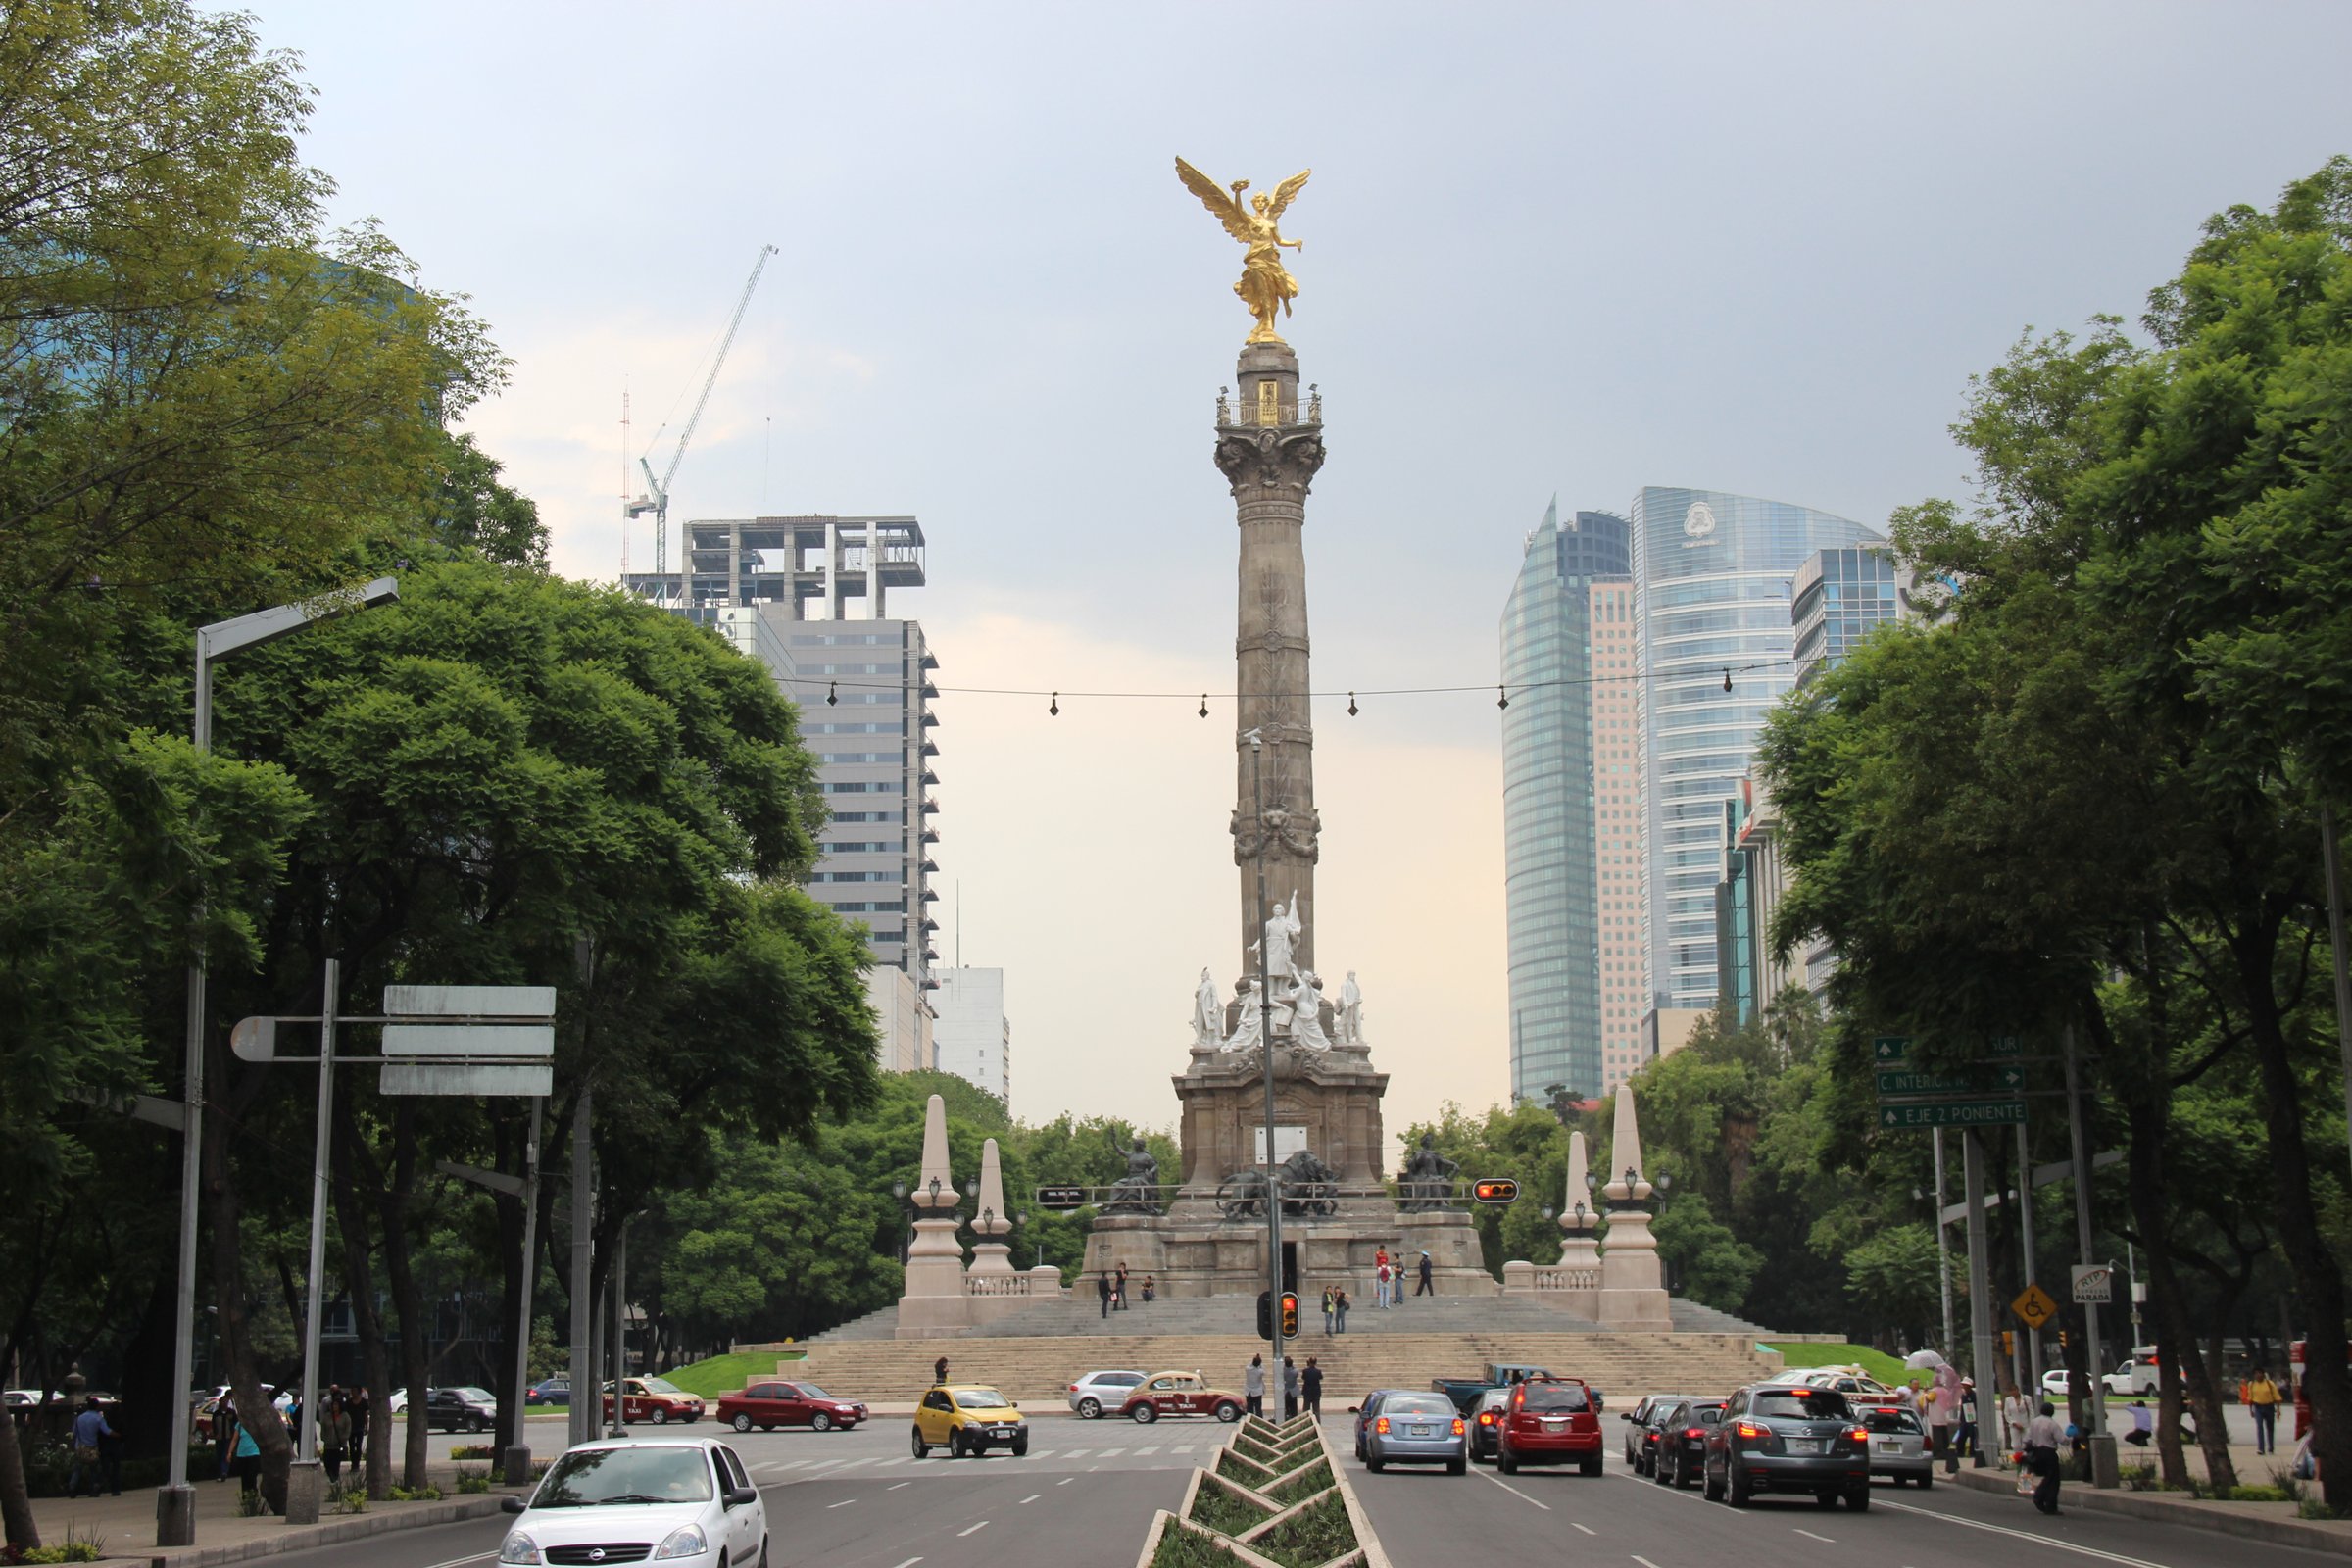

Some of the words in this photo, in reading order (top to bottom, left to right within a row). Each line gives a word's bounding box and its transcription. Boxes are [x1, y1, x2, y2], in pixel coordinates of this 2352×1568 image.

[1880, 1075, 1892, 1090] C.
[1905, 1108, 1932, 1123] EJE
[1937, 1107, 1947, 1122] 2
[1952, 1104, 2024, 1121] PONIENTE
[2081, 1271, 2101, 1287] RTP
